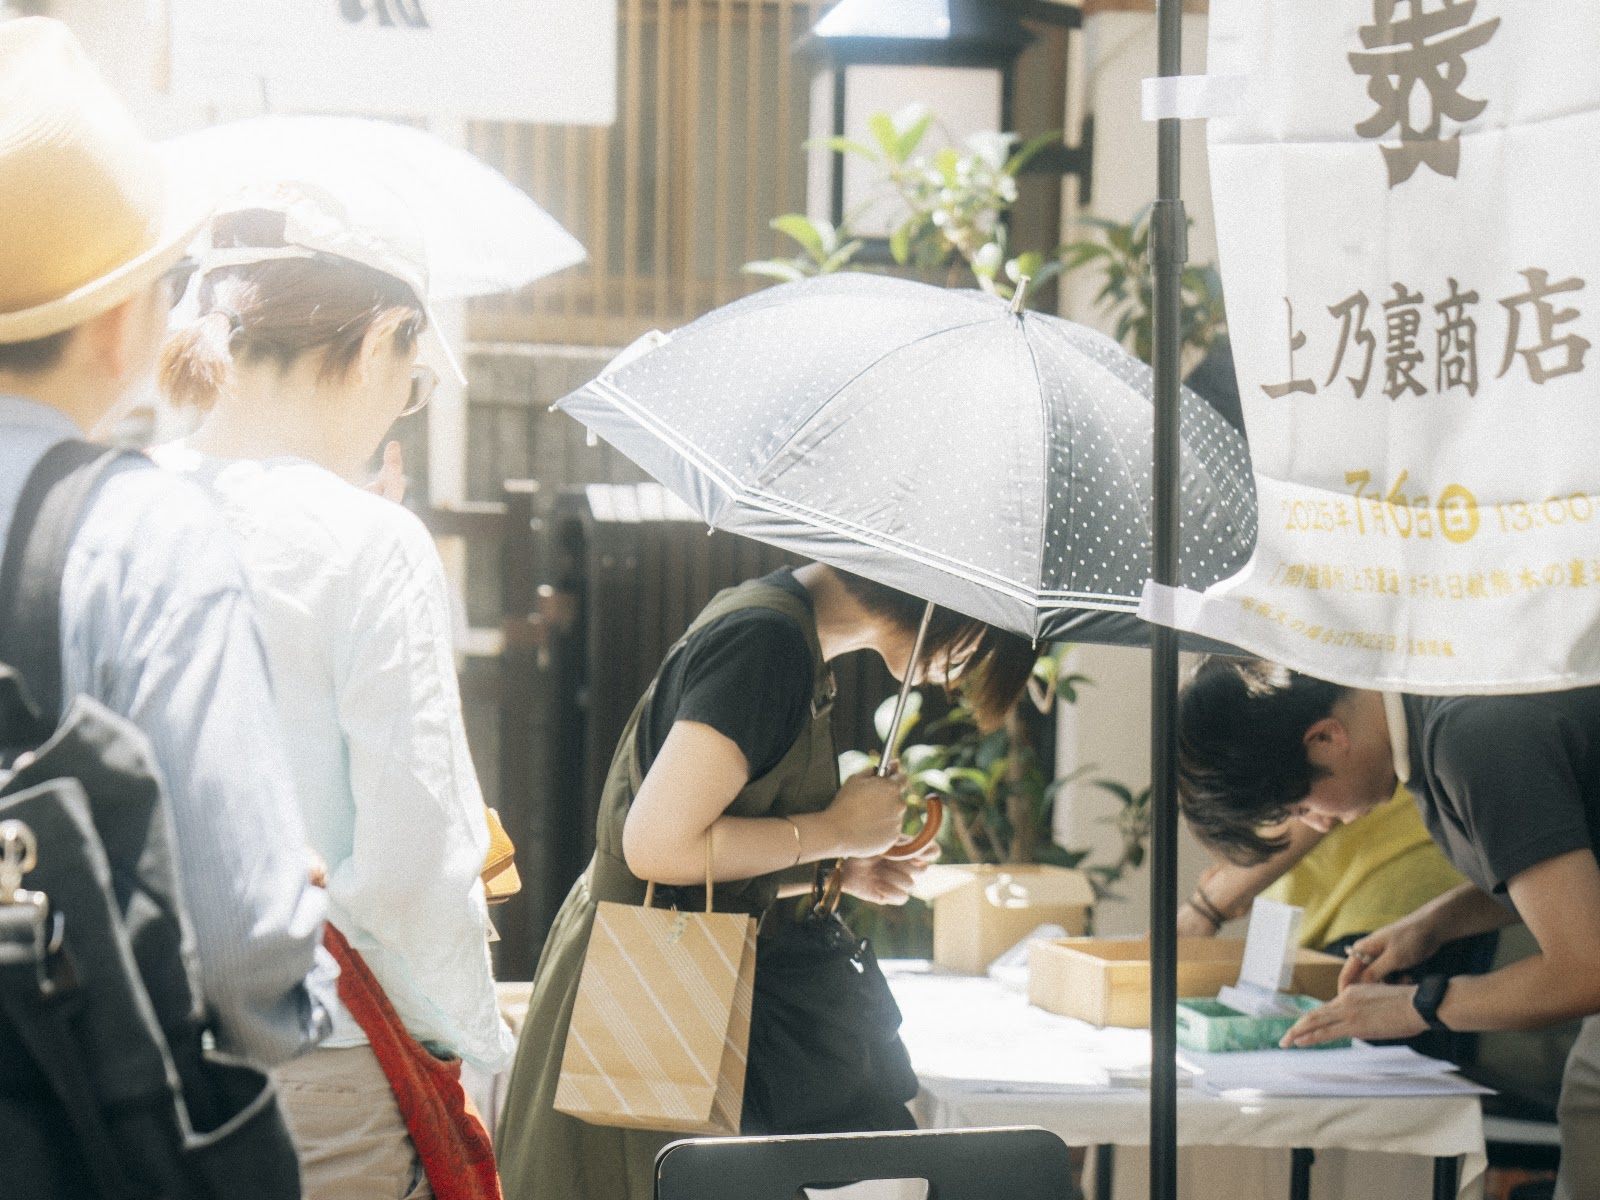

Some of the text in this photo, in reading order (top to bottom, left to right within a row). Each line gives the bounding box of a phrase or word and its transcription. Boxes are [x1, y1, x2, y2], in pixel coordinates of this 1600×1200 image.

[1260, 267, 1592, 401] 上乃裏商店
